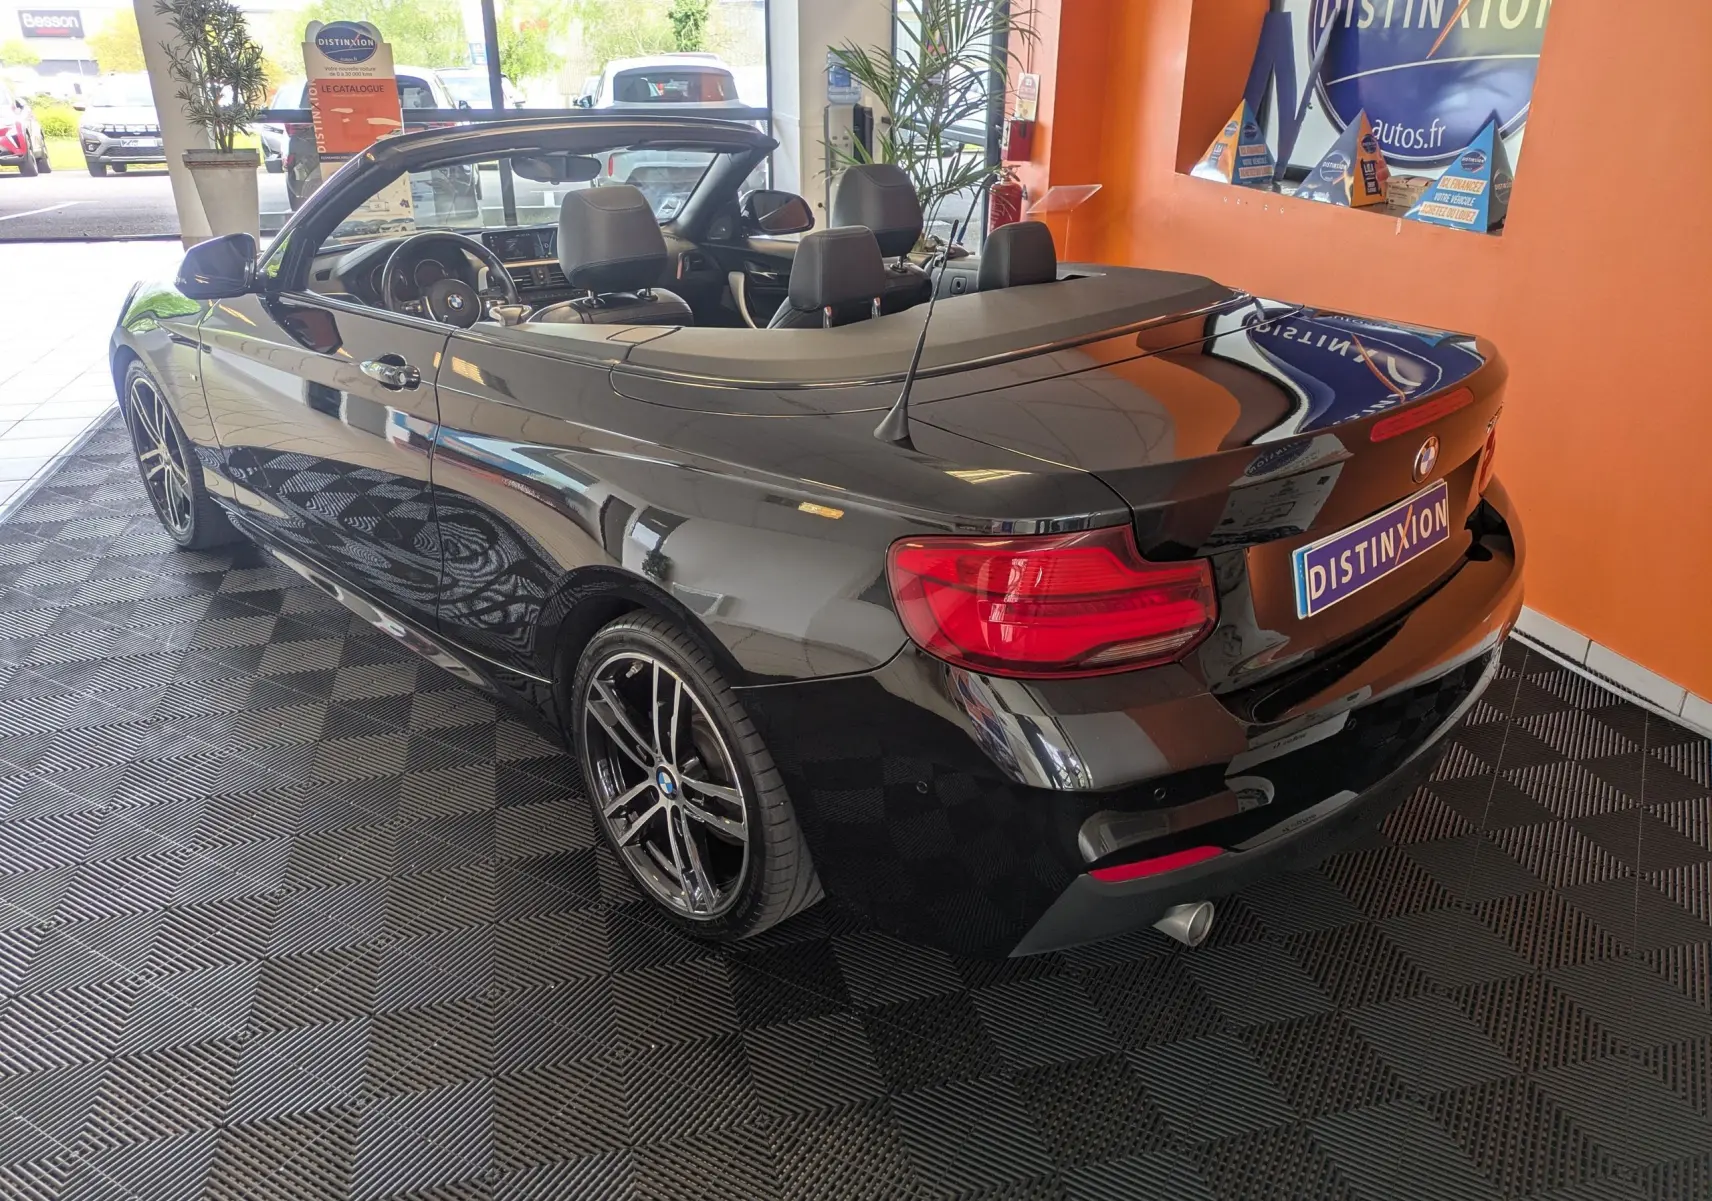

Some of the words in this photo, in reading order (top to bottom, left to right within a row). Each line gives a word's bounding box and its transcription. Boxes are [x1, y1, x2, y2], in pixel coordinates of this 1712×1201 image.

[22, 12, 80, 28] Besson
[318, 36, 375, 47] DISTINXION
[321, 85, 331, 93] LE
[333, 84, 385, 93] CATALOGUE
[1372, 118, 1446, 149] autos.fr
[1309, 498, 1447, 601] DISTINXION
